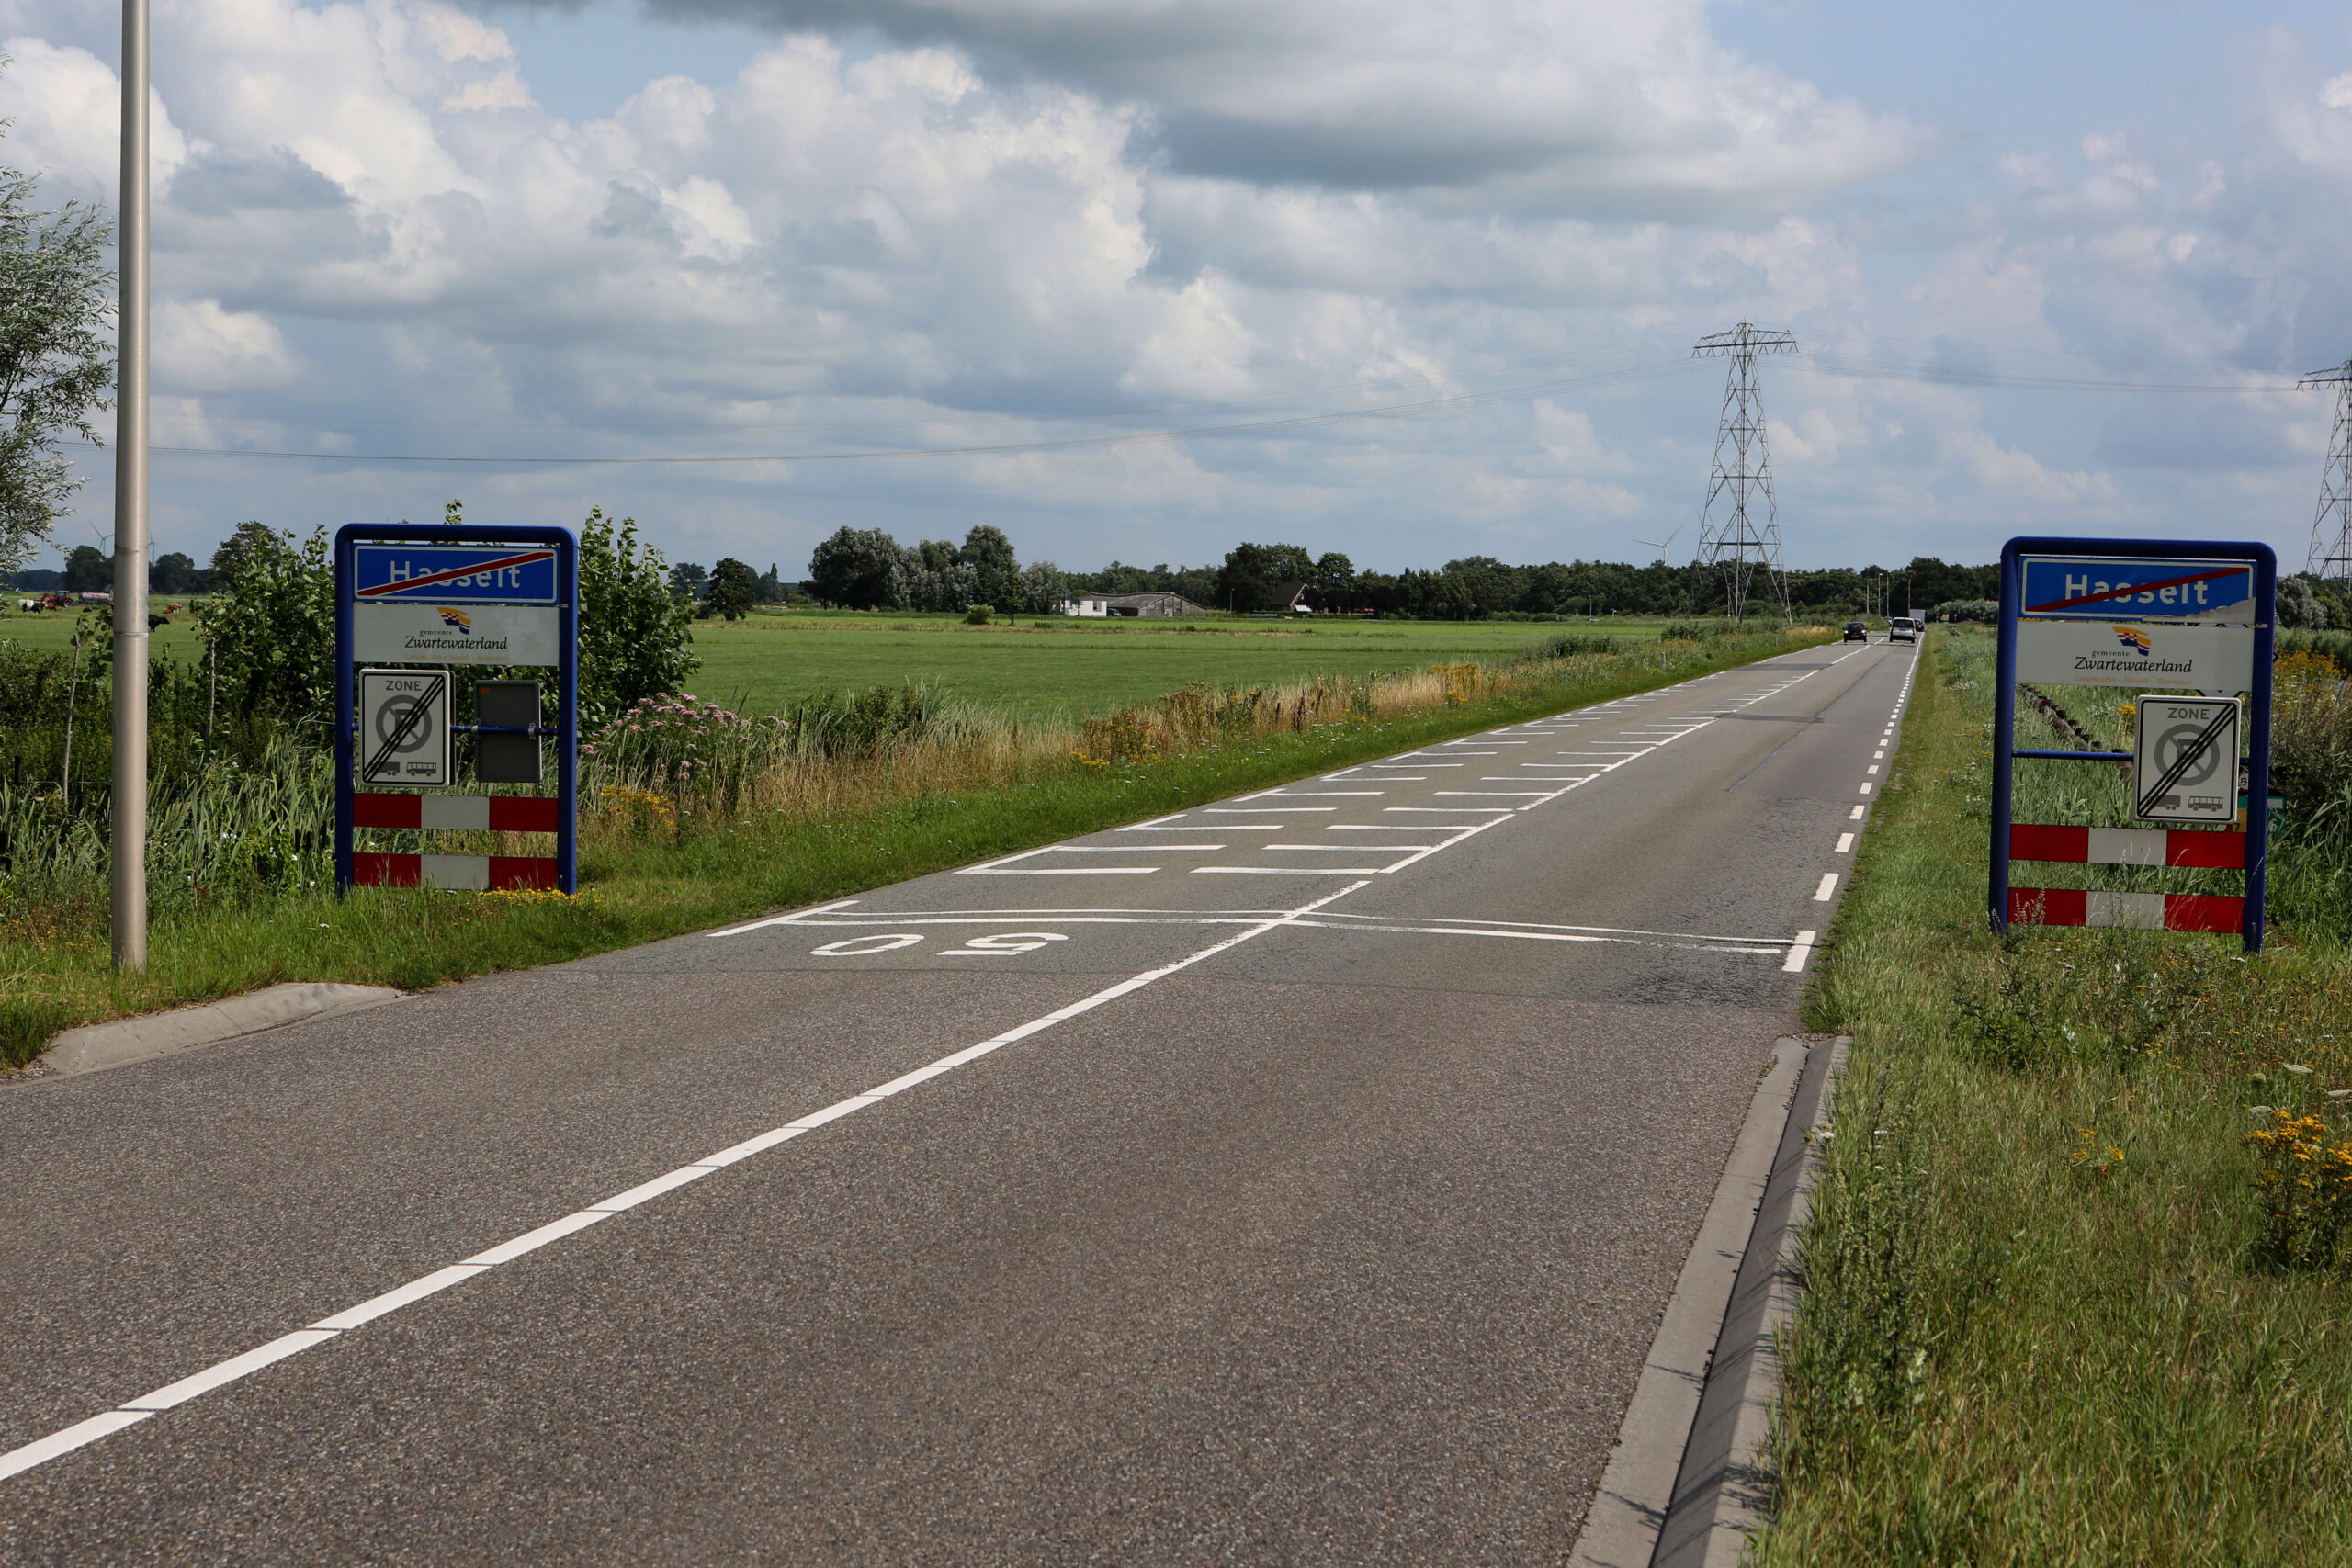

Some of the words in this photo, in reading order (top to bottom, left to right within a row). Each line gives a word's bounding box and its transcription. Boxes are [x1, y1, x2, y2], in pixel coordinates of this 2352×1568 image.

[2064, 574, 2209, 604] Hasselt
[419, 629, 453, 637] gemeente
[404, 636, 508, 649] Zwartewaterland
[2091, 649, 2131, 658] gemeente
[2074, 656, 2193, 673] Zwartewaterland
[385, 680, 423, 692] ZONE
[2167, 707, 2211, 720] ZONE
